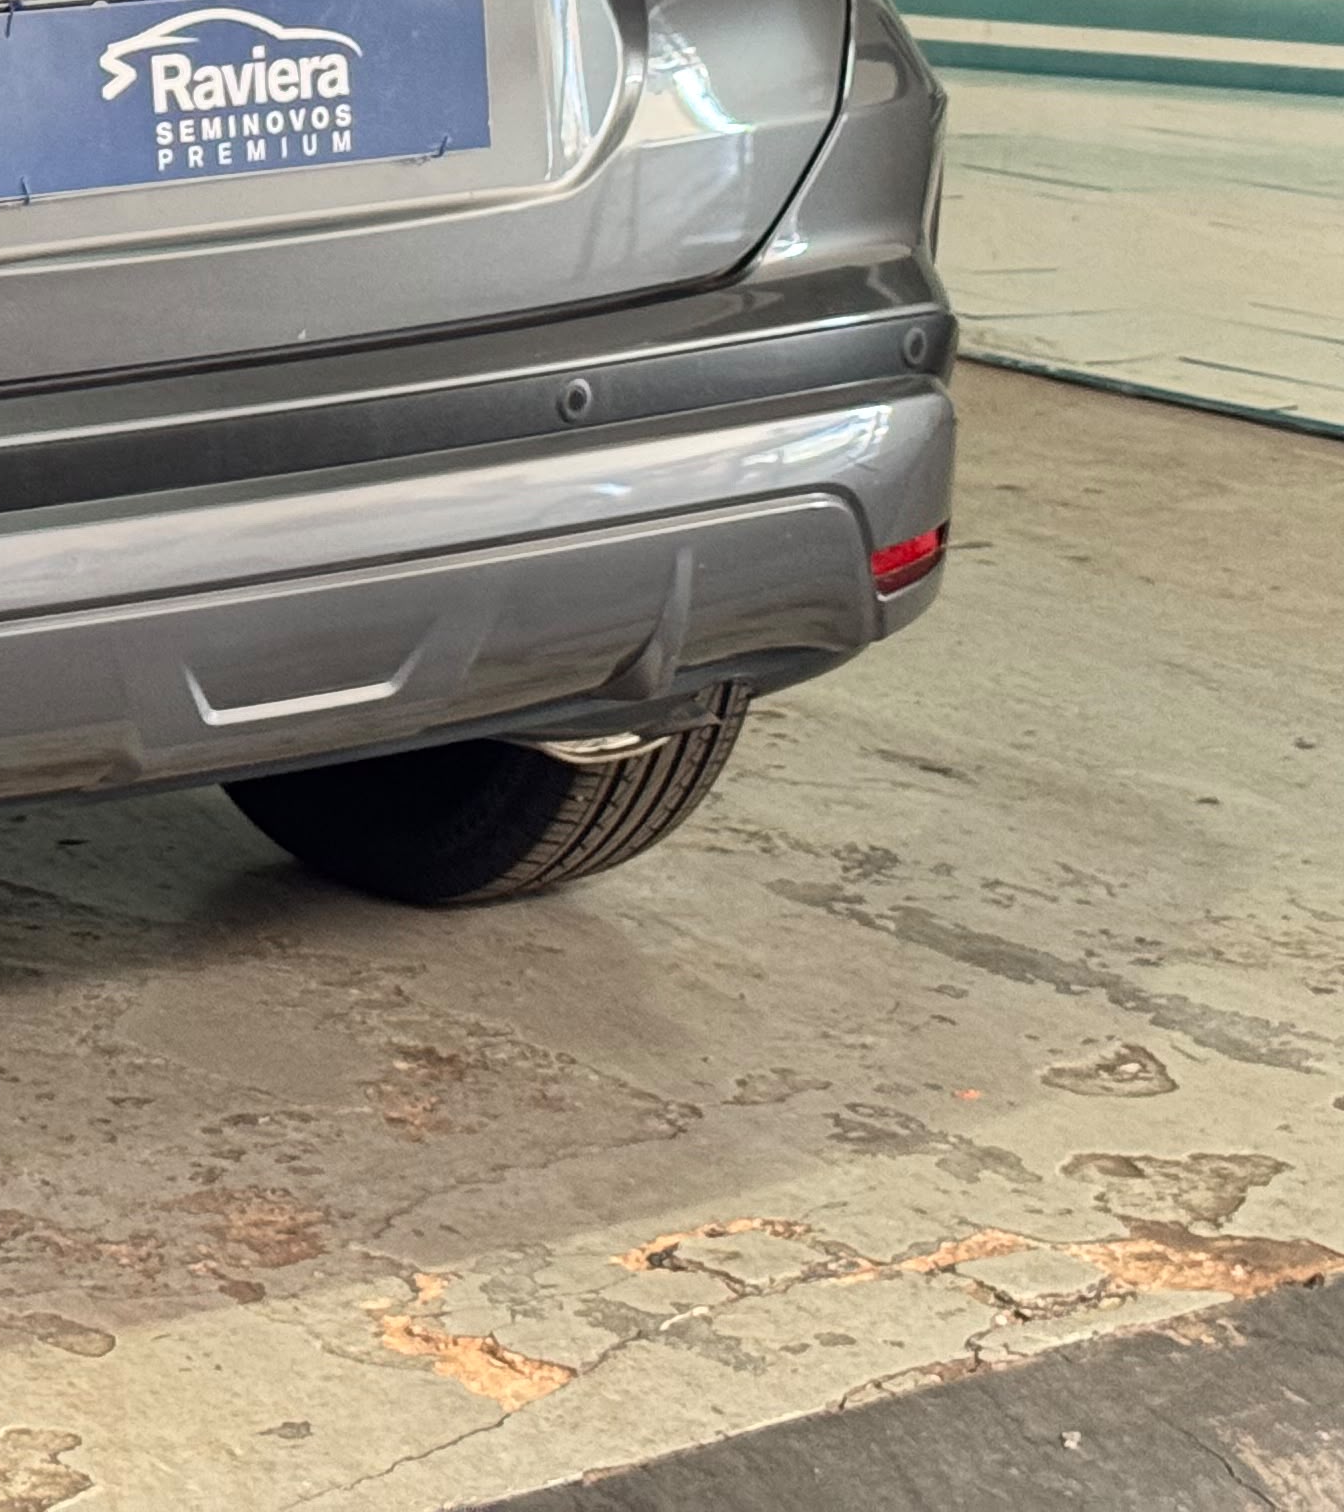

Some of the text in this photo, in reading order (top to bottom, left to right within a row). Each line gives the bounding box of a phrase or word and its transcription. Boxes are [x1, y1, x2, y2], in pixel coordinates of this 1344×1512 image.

[150, 45, 351, 114] Raviera
[154, 102, 353, 146] SEMINOVOS
[157, 130, 353, 172] PREMIUM
